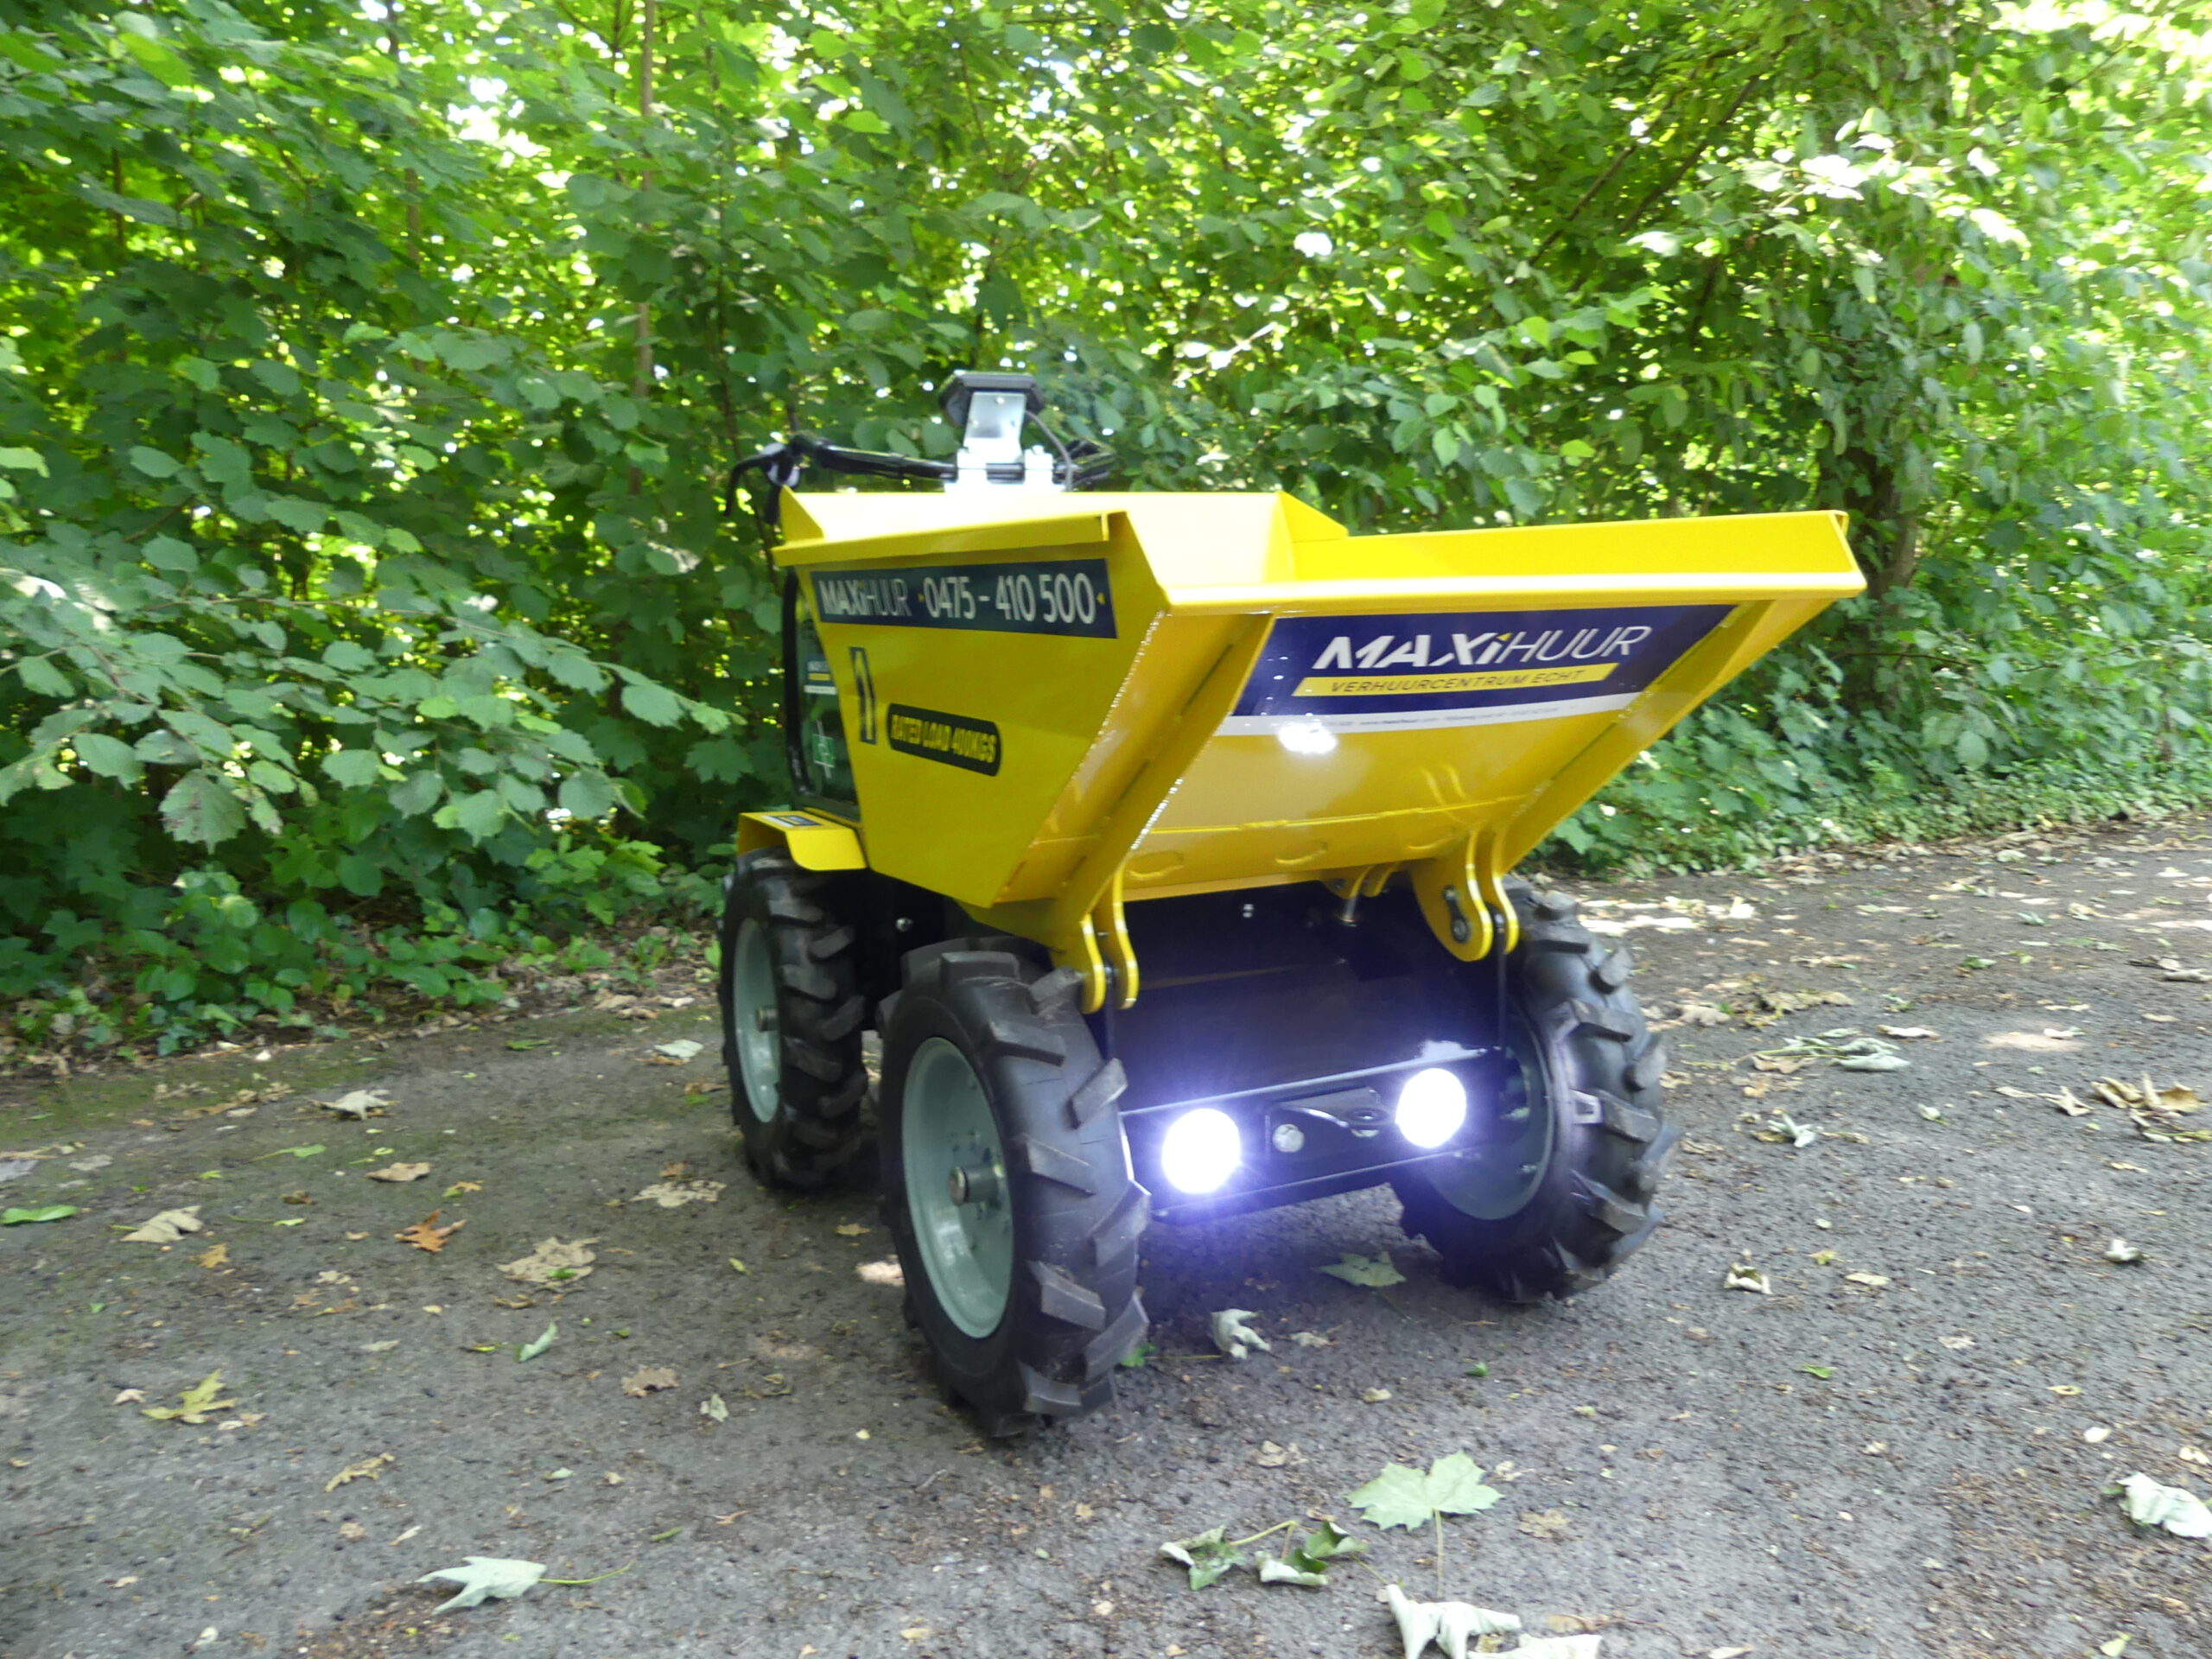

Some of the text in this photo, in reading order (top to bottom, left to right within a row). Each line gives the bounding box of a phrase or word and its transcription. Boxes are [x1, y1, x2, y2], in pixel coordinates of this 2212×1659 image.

[1331, 669, 1585, 692] VERHUURCENTRUM ECHT
[891, 715, 922, 745] RATED
[921, 721, 951, 752] LOAD
